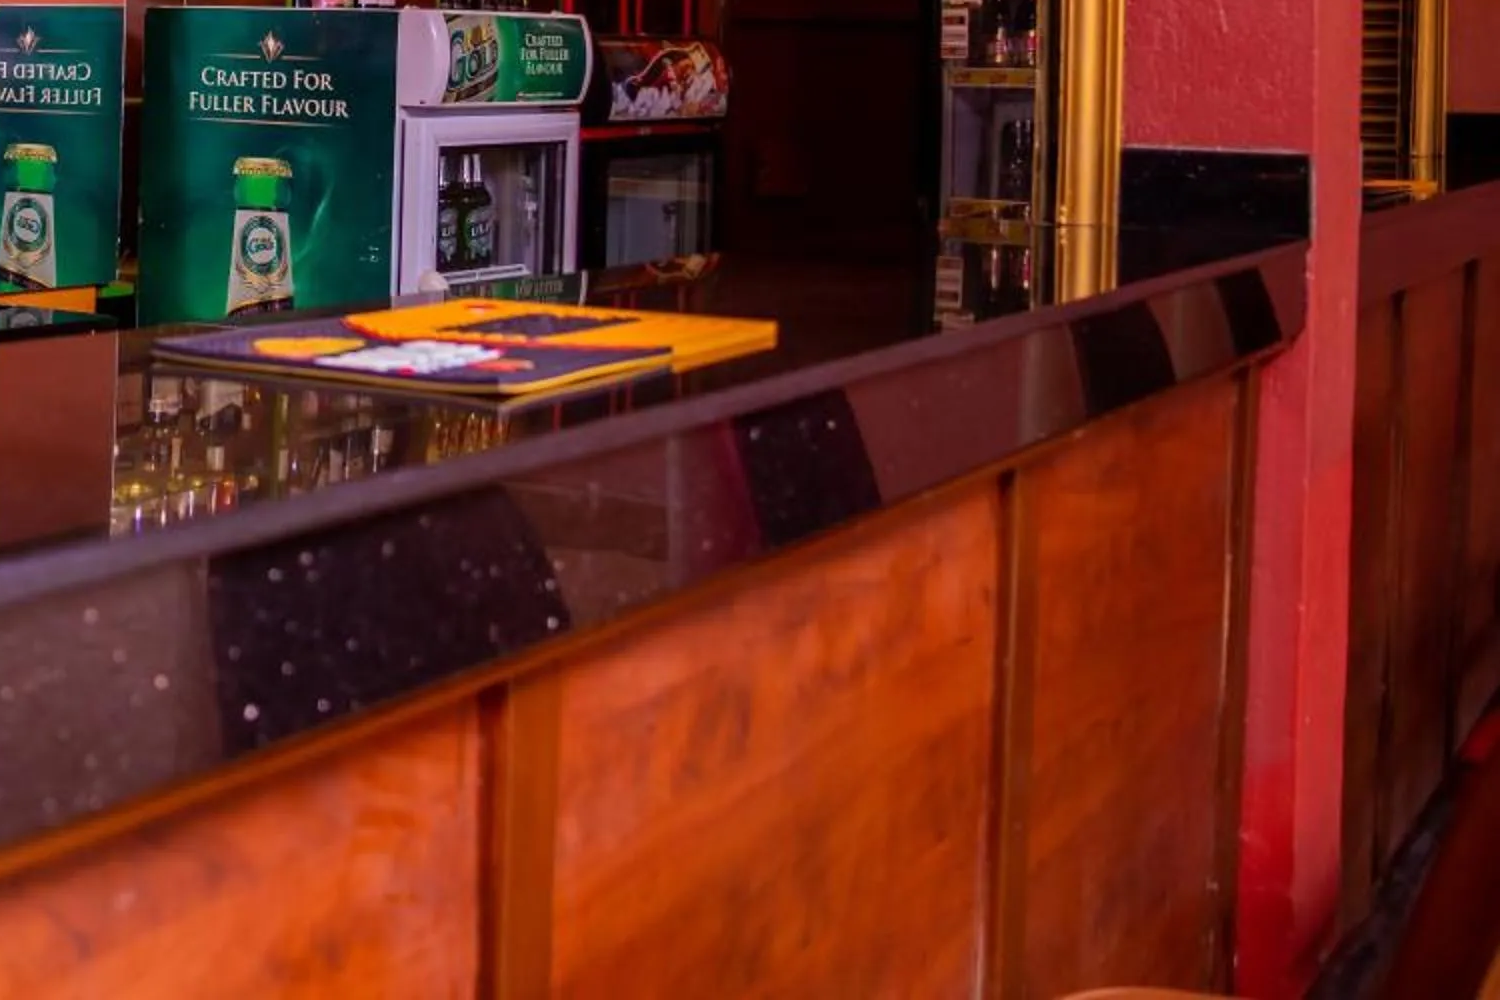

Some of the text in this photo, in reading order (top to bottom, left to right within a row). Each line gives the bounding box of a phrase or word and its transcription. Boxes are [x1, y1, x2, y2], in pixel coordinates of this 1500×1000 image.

[525, 33, 564, 47] CRAFTED
[201, 66, 334, 91] CRAFTED FOR
[189, 91, 349, 119] FULLER FLAVOUR
